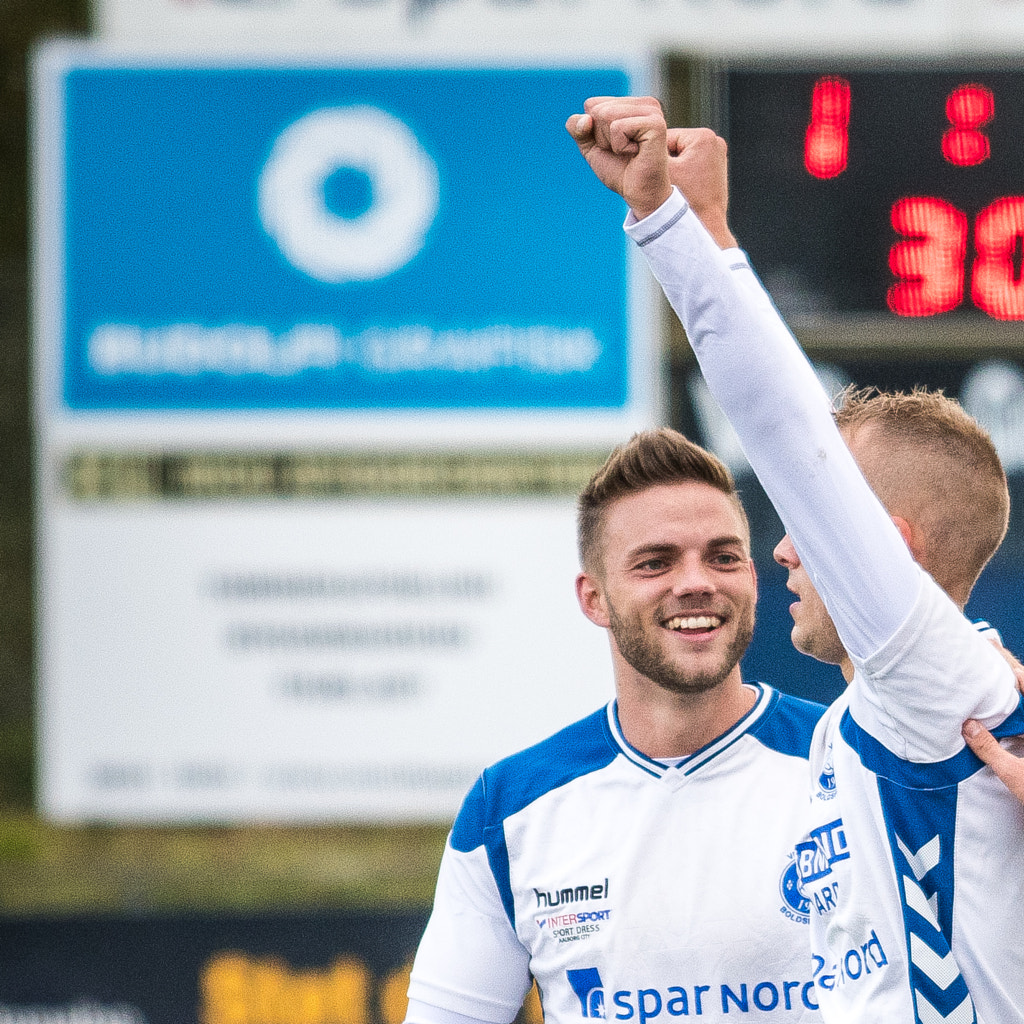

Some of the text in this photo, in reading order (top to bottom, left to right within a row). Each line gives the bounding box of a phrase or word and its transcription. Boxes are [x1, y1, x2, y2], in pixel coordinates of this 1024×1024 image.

[804, 75, 851, 179] 1
[533, 878, 609, 908] hummel
[547, 909, 611, 928] INTERSPORT
[553, 924, 601, 938] SPORT DRESS
